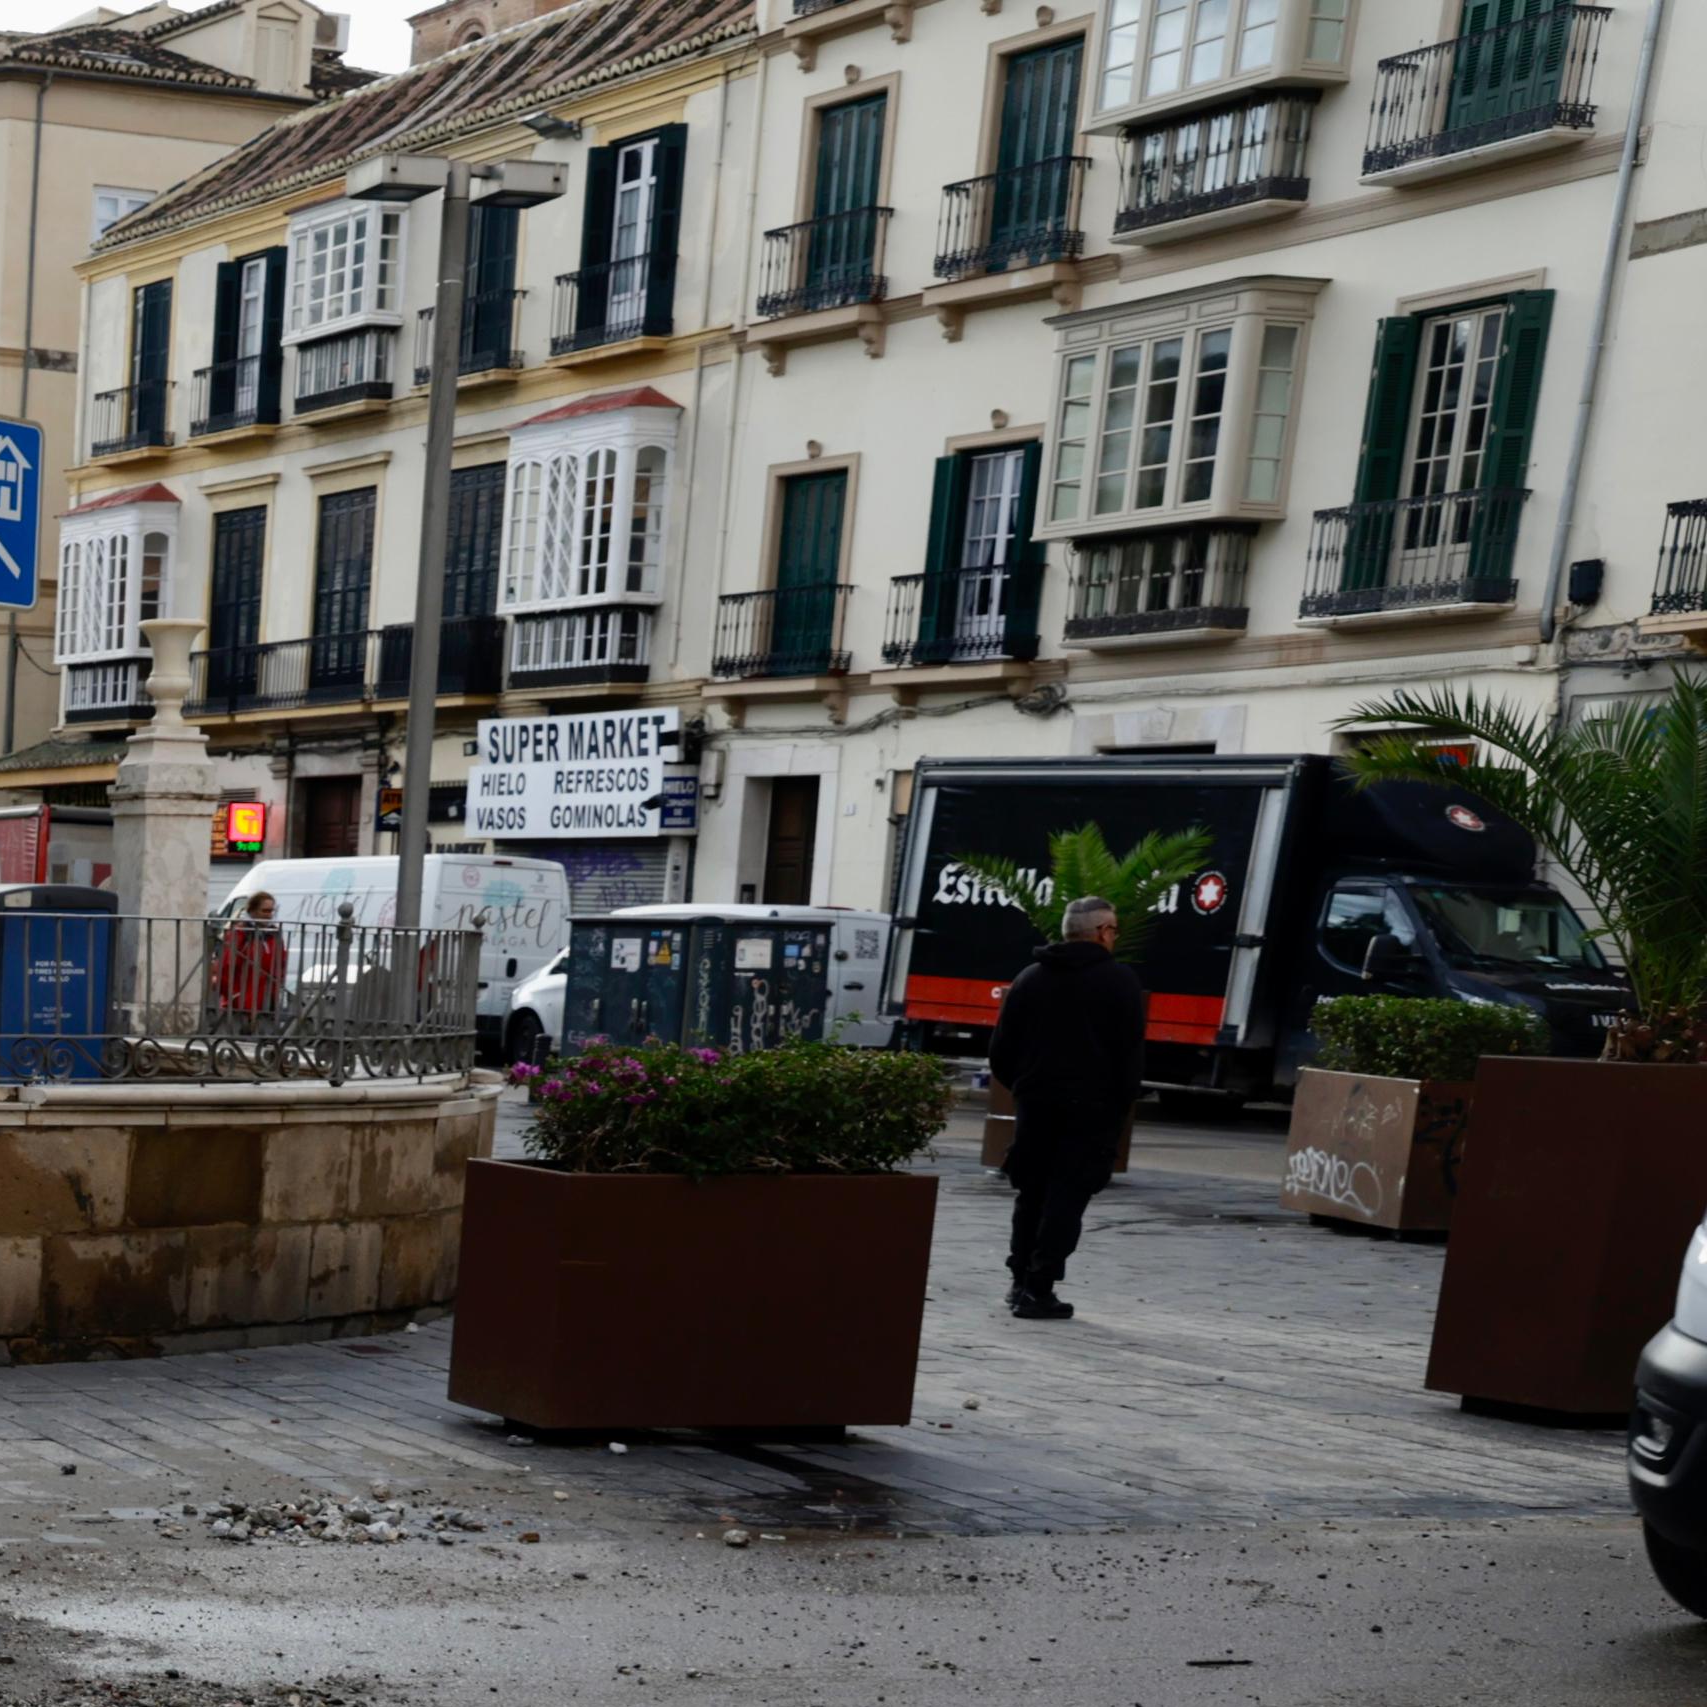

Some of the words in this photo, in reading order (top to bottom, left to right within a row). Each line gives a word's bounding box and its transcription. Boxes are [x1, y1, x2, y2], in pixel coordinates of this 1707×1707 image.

[488, 722, 560, 765] SUPER
[568, 715, 666, 761] MARKET
[480, 772, 527, 797] HIELO
[553, 767, 650, 795] REFRESCOS
[477, 806, 527, 831] VASOS
[550, 804, 648, 830] GOMINOLAS
